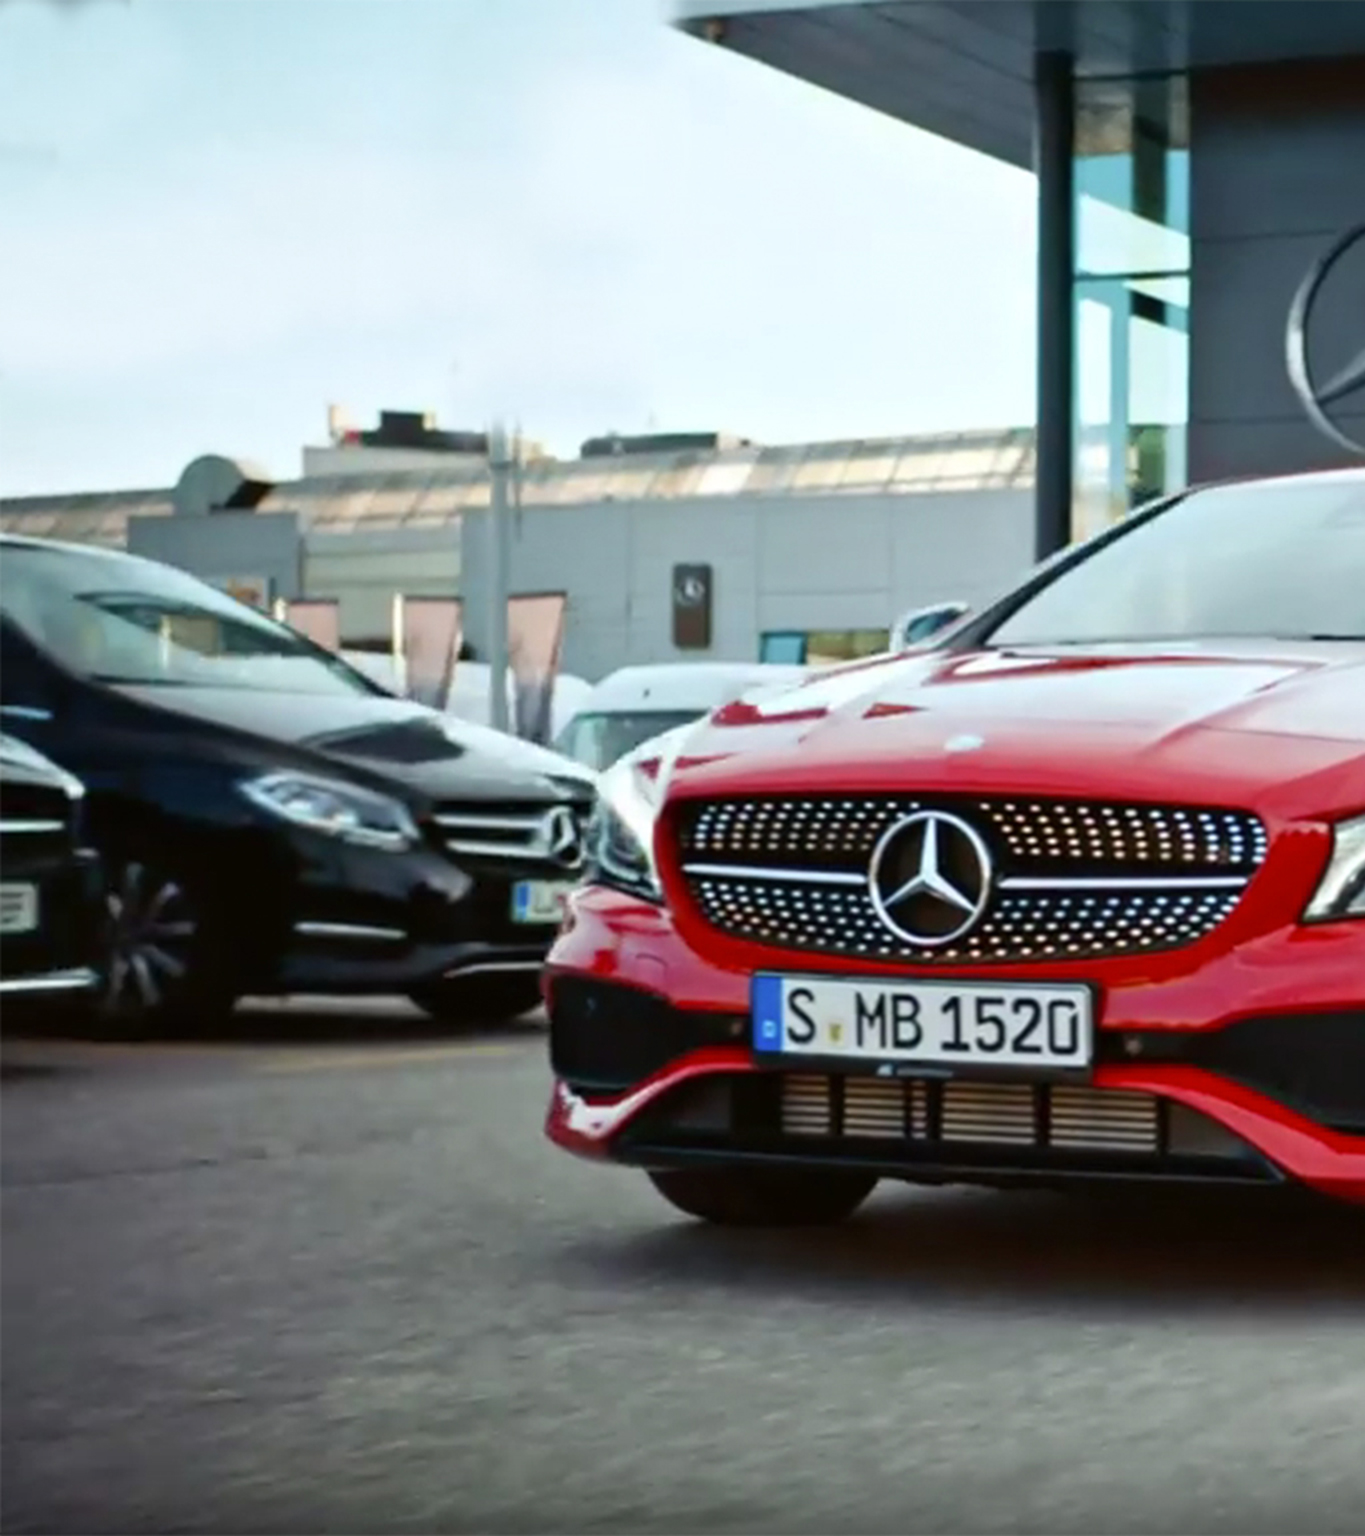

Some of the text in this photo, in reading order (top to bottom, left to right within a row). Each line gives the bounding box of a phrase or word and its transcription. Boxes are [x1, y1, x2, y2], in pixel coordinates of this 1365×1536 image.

[787, 988, 1079, 1054] S MB 1520
